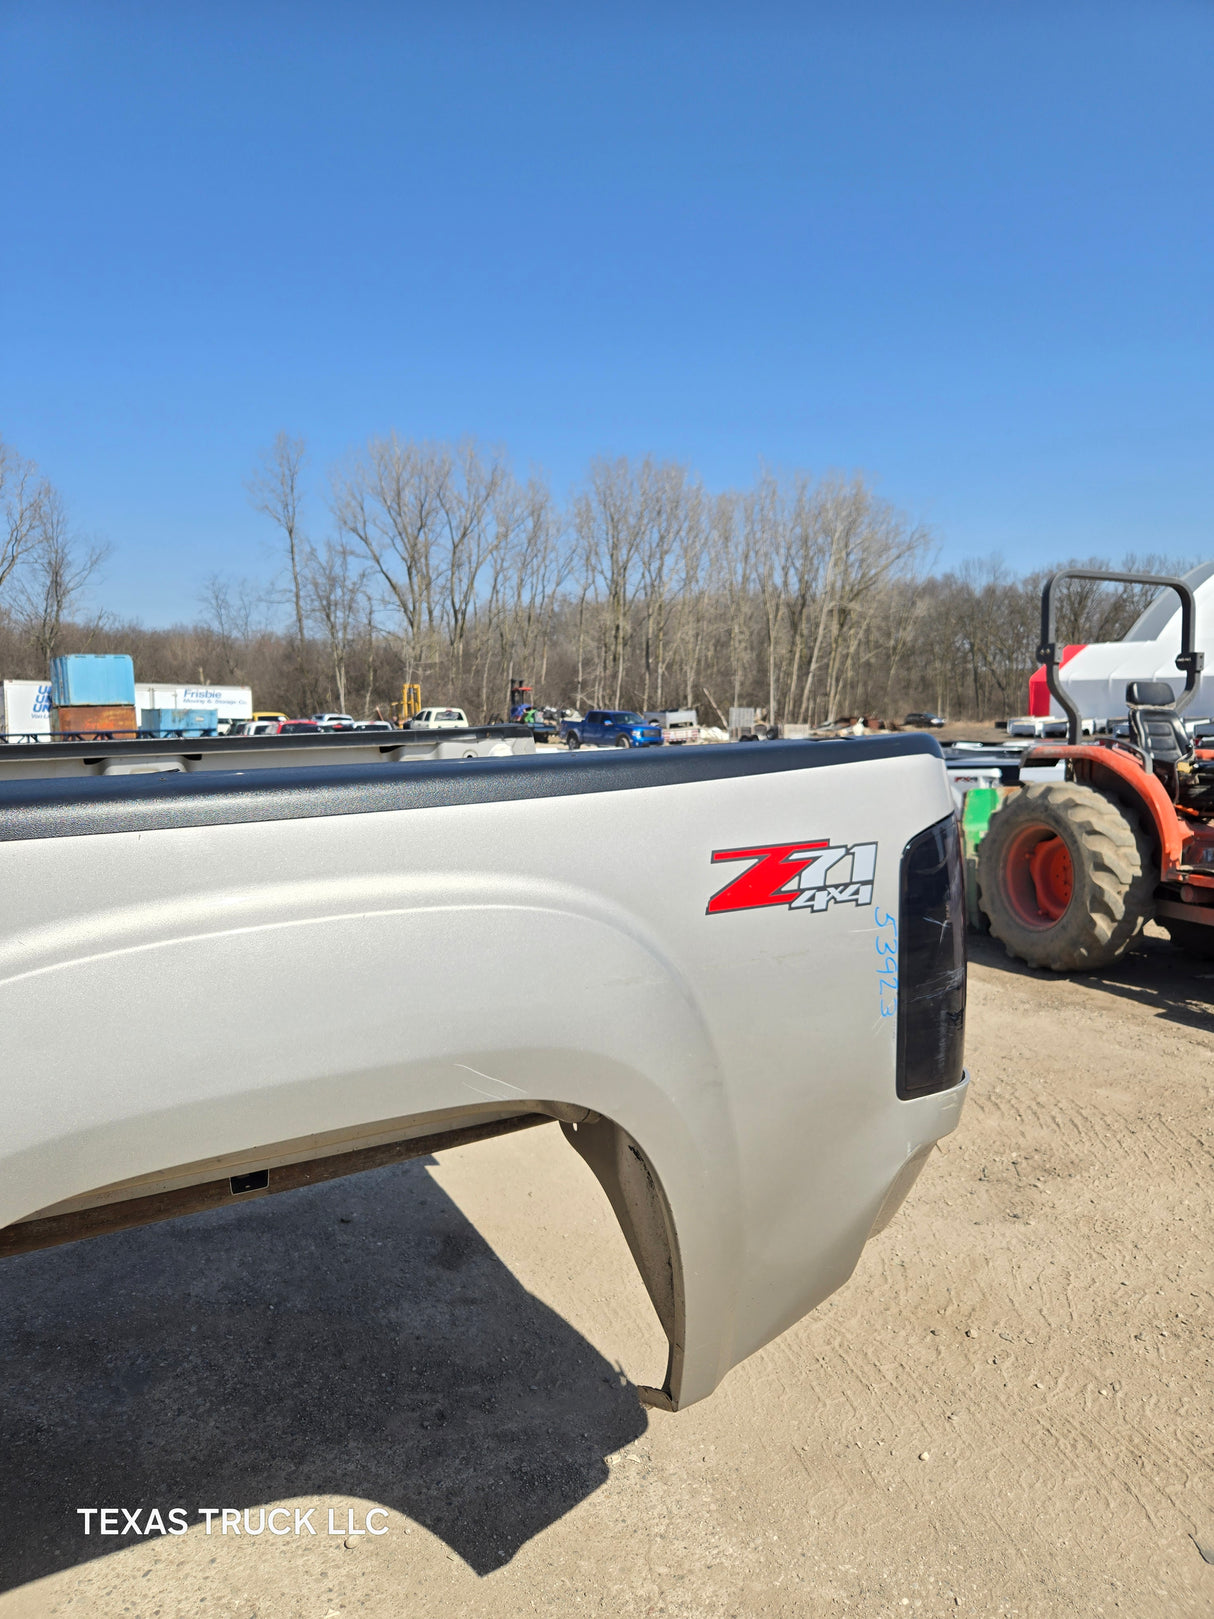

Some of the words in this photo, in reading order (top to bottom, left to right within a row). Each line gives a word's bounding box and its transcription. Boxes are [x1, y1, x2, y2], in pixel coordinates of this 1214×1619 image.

[183, 688, 222, 699] Frisbie
[705, 838, 878, 915] Z71
[874, 906, 899, 1018] 53923
